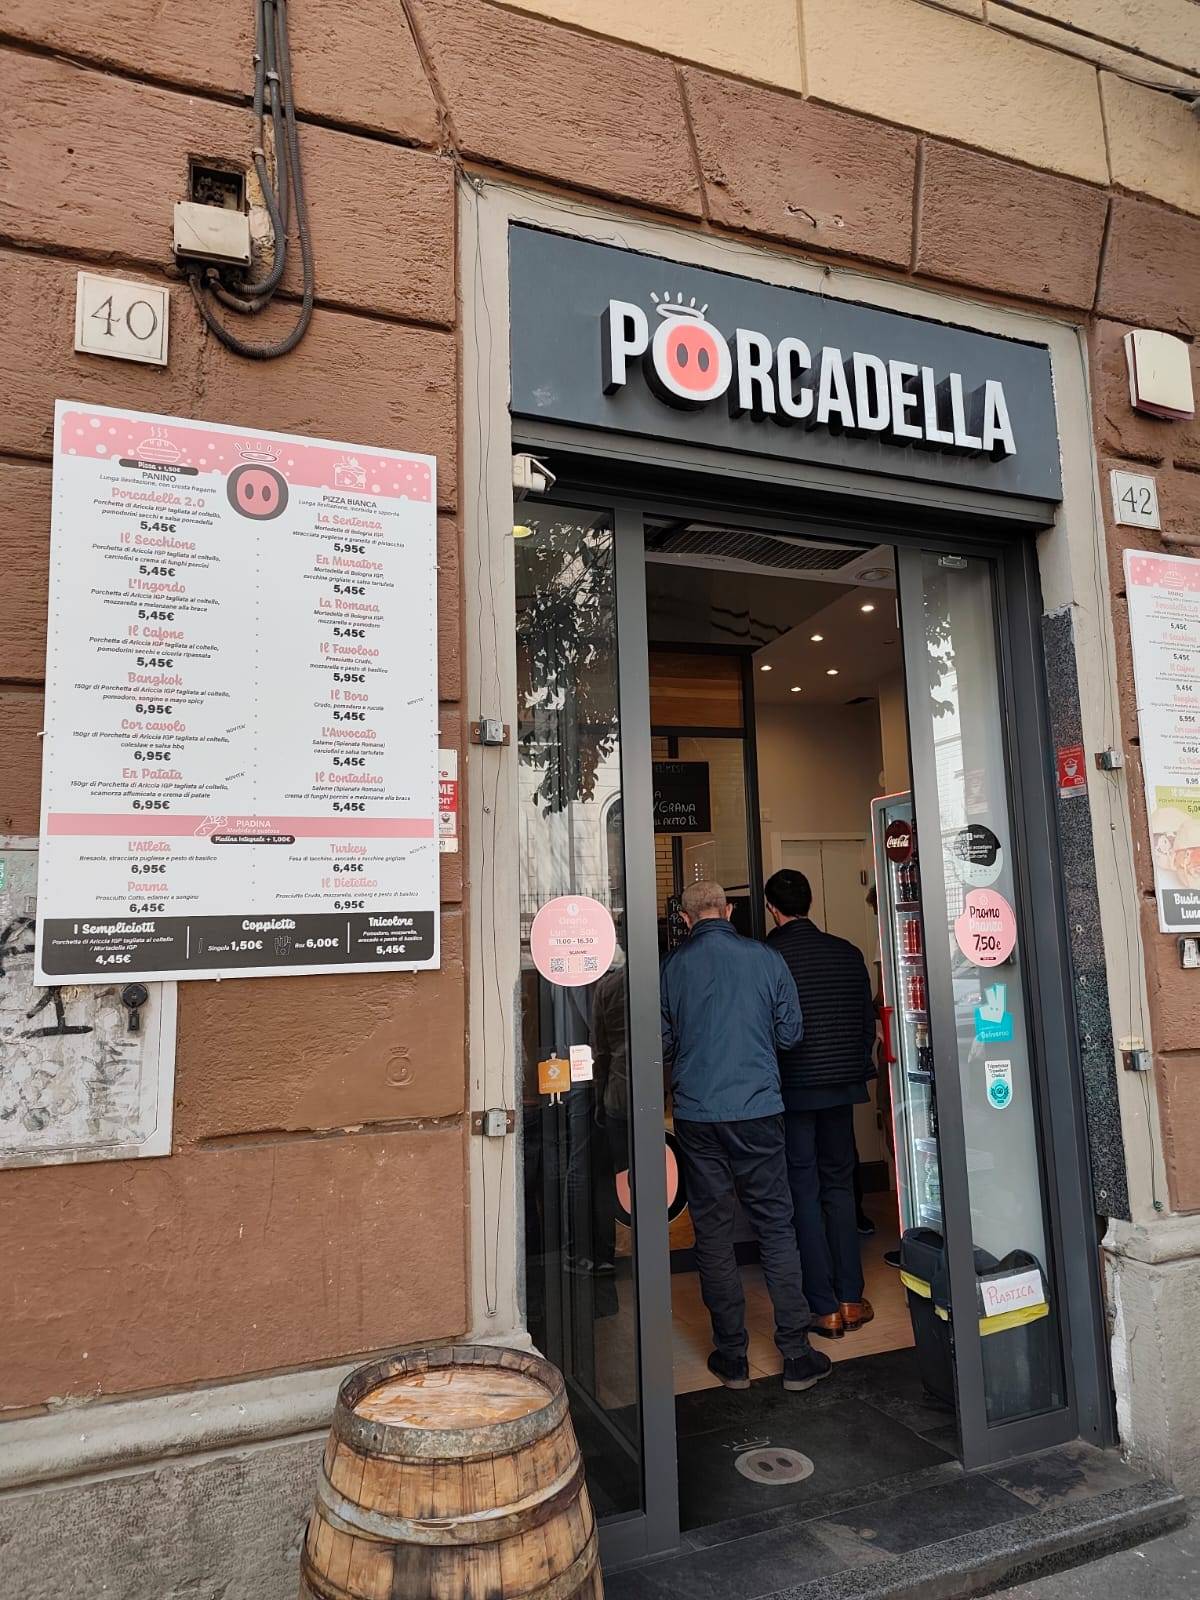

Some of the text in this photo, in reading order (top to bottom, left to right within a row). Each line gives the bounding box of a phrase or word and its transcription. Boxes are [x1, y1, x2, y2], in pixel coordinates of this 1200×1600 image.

[91, 296, 158, 339] 40
[608, 298, 1016, 456] PORCADELLA
[142, 471, 177, 483] PANINO
[111, 486, 182, 505] Porcadella
[322, 495, 377, 508] PIZZA BIANCA
[1121, 486, 1152, 515] 42
[140, 520, 176, 533] 5,45€
[317, 512, 382, 530] La Sentenza
[120, 531, 196, 551] Il Secchione
[333, 542, 365, 554] 5,95€
[139, 564, 176, 577] 5,45€
[128, 577, 186, 593] L'Ingordo
[333, 584, 365, 595] 5,45€
[319, 596, 380, 613] La Romana
[137, 609, 175, 621] 5,45€
[333, 627, 365, 638] 5,45€
[319, 641, 379, 657] Il Favoloso
[136, 656, 173, 668] 5,45€
[127, 671, 183, 686] Bangkok
[333, 672, 365, 683] 5,95€
[330, 688, 368, 702] Il Boro
[135, 703, 172, 715] 6,95€
[333, 710, 365, 721] 5,45€
[121, 718, 186, 732] Cor cavolo
[321, 726, 377, 739] L'Avvocato
[133, 750, 171, 761] 6,95€
[332, 756, 365, 767] 5,45€
[315, 770, 383, 784] Il Contadino
[132, 799, 170, 810] 6,95€
[332, 802, 365, 812] 5,45€
[236, 819, 271, 828] PIADINA
[128, 840, 171, 852] L'Atleta
[329, 842, 367, 855] Turkey
[130, 864, 166, 875] 6,95€
[332, 863, 364, 873] 6,45€
[127, 880, 169, 892] Parma
[321, 876, 378, 888] Il Dietetico
[129, 902, 165, 914] 6,45€
[333, 900, 365, 910] 6,95€
[970, 906, 1000, 919] Promo
[241, 918, 296, 932] Coppiette
[368, 915, 413, 927] Tricolore
[73, 921, 155, 936] I Sempliciotti
[230, 940, 263, 951] 1,50€
[306, 937, 339, 948] 6,00€
[376, 944, 405, 955] 5,45€
[95, 954, 131, 965] 4,45€
[987, 1286, 1034, 1305] PLASTICA
